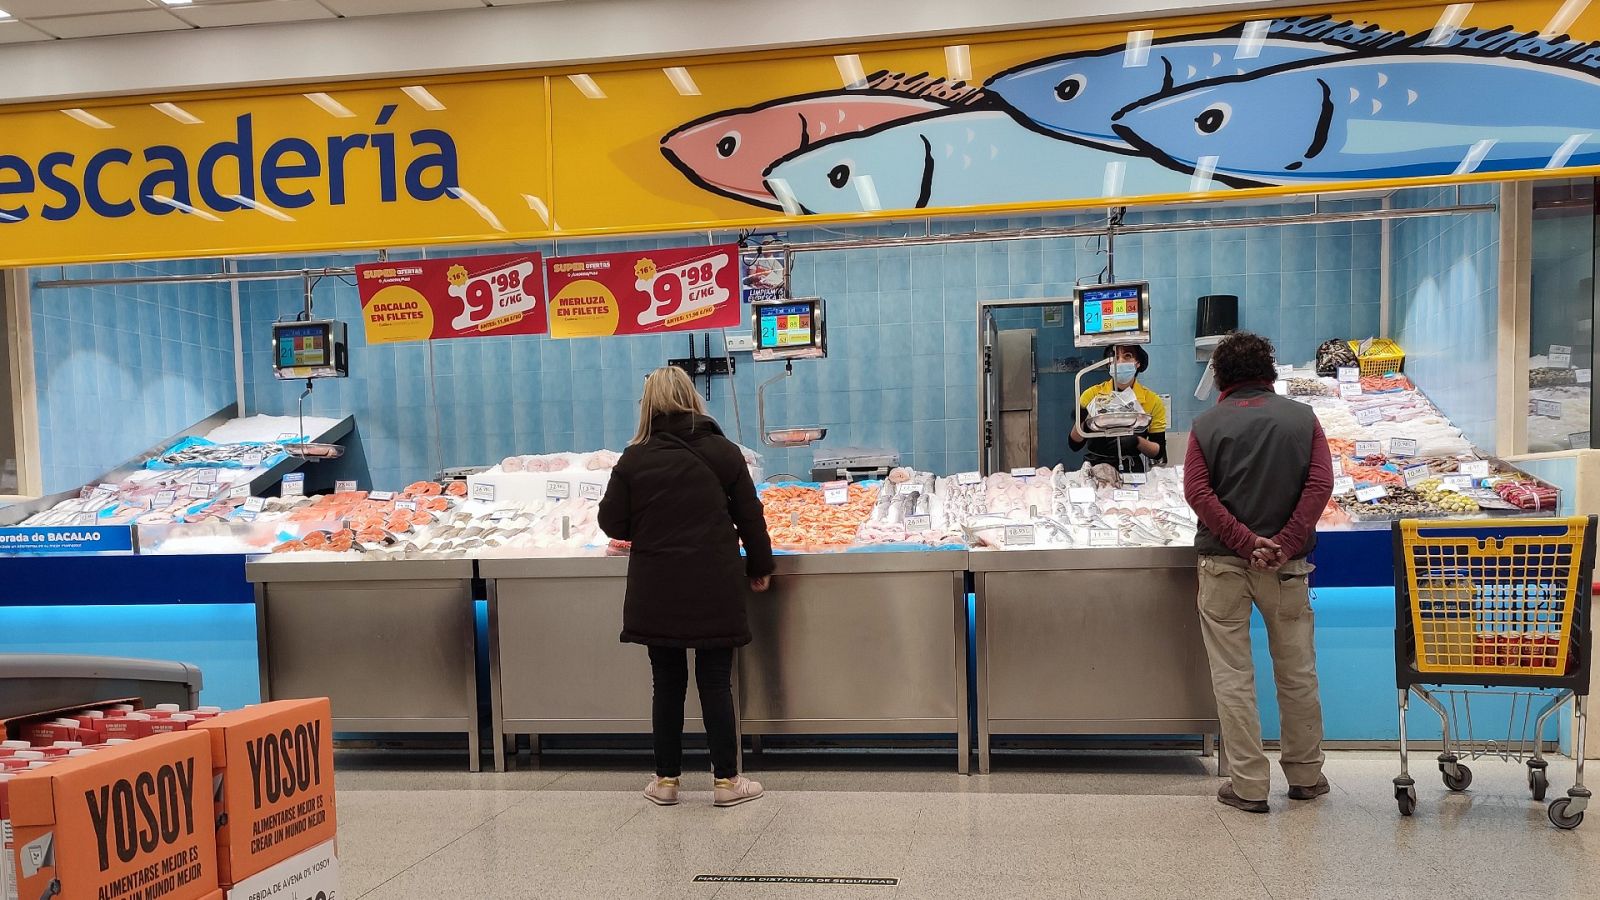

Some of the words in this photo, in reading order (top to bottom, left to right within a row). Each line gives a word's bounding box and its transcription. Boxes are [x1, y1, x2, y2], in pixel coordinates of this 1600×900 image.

[363, 268, 396, 279] SUPER
[396, 267, 423, 276] OFERTAS
[553, 262, 585, 273] SUPER
[585, 261, 610, 270] OFERTAS
[689, 286, 714, 301] €/KG
[373, 301, 418, 312] BACALAO
[559, 296, 606, 306] MERLUZA
[371, 314, 384, 322] EN
[386, 311, 424, 321] FILETES
[557, 308, 570, 316] EN
[572, 305, 609, 315] FILETES
[1086, 312, 1099, 323] 21
[762, 326, 775, 338] 21
[281, 347, 292, 358] 21
[32, 532, 45, 542] de
[47, 531, 101, 541] BACALAO
[247, 719, 320, 810] YOSOY
[85, 756, 195, 872] YOSOY
[253, 806, 296, 836] ALIMENTARSE
[297, 798, 315, 818] MEJOR
[316, 794, 323, 809] ES
[251, 833, 273, 854] CREAR
[274, 828, 283, 844] UN
[285, 818, 306, 839] MUNDO
[308, 809, 326, 829] MEJOR
[98, 862, 159, 900] ALIMENTARSE
[161, 850, 187, 875] MEJOR
[189, 844, 198, 862] ES
[273, 881, 281, 894] DE
[283, 871, 302, 890] AVENA
[312, 857, 330, 874] YOSOY
[145, 875, 175, 900] MUNDO
[177, 862, 202, 888] MEJOR
